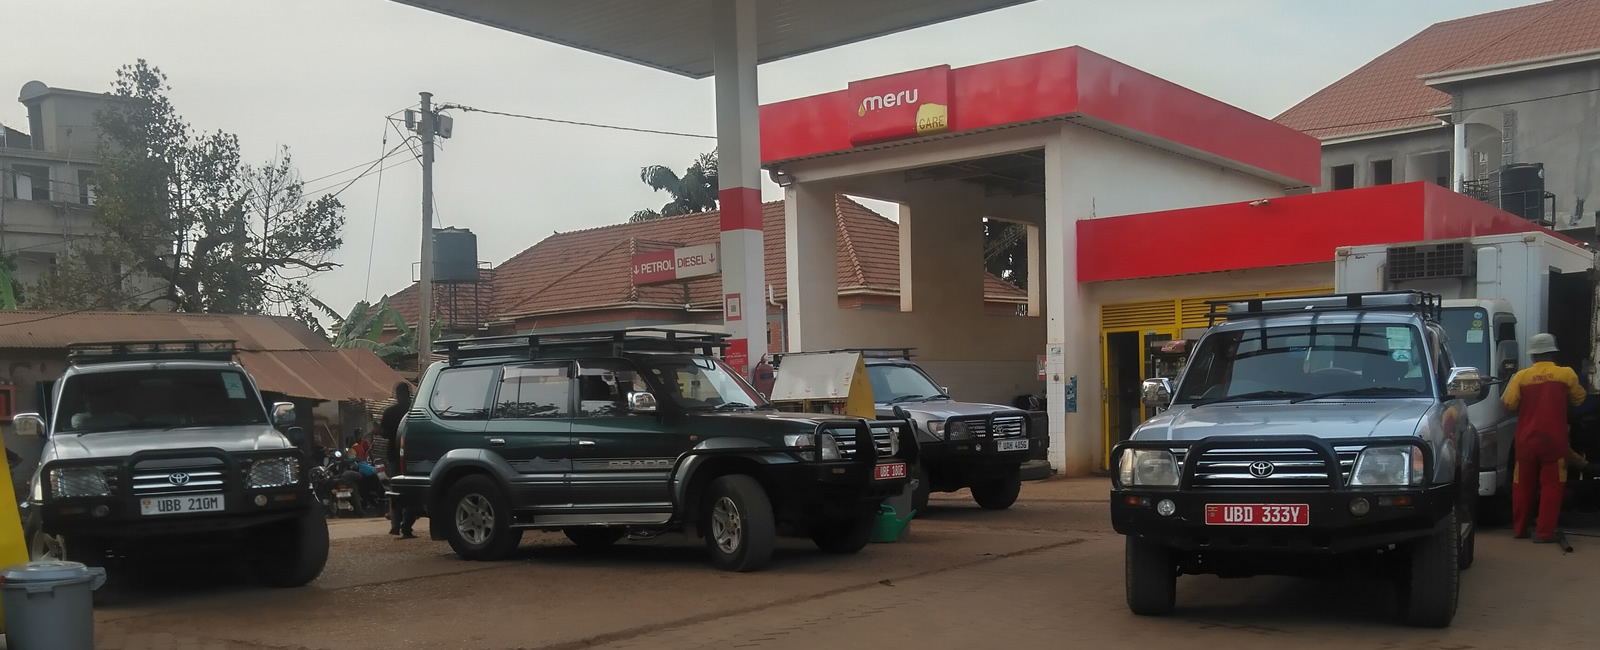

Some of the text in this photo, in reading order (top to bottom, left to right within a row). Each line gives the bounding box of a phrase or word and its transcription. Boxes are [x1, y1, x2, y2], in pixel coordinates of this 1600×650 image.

[862, 88, 918, 111] meru
[919, 115, 944, 130] CARE
[641, 259, 675, 274] PETROL
[677, 255, 706, 268] DIESEL
[880, 466, 890, 477] UBE
[157, 497, 219, 512] UBB 210M
[1224, 506, 1300, 523] UBD 333Y
